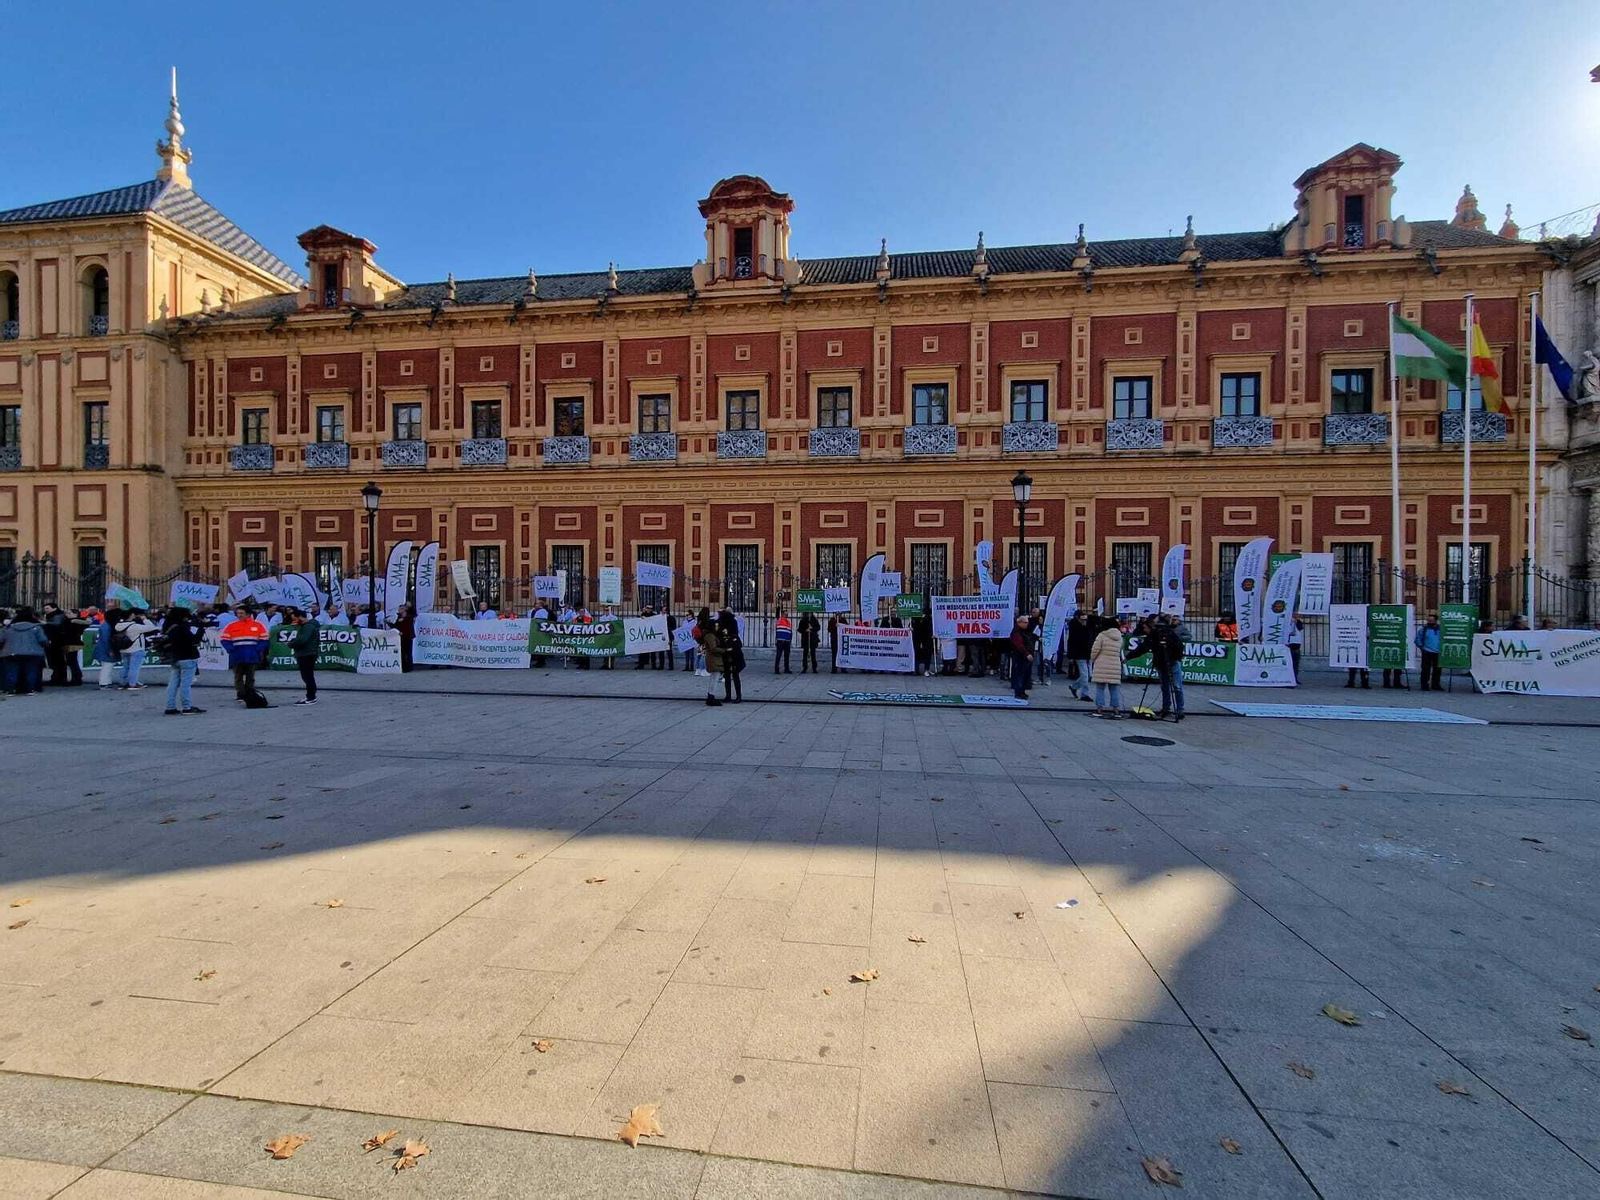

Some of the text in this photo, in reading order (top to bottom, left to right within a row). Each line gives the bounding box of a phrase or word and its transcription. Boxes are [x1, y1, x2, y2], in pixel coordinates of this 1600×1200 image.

[390, 556, 404, 588] SMA
[419, 557, 433, 588] SMA
[537, 580, 558, 591] SMA
[880, 578, 899, 588] MA
[177, 584, 208, 595] SMA
[346, 583, 361, 596] SM
[798, 593, 818, 604] SMA
[827, 594, 847, 603] SMA
[898, 599, 918, 609] SMA
[946, 610, 1001, 620] NO PODEMOS
[1241, 595, 1251, 631] SMA
[540, 622, 610, 635] SALVEMOS
[629, 625, 664, 641] SMA
[957, 621, 990, 634] MÁS
[278, 629, 357, 644] SAEMOS
[551, 635, 595, 644] nuestra
[678, 631, 692, 642] SM
[534, 645, 618, 655] ATENCIÓN PRIMARIA
[1481, 638, 1541, 658] SMA
[271, 655, 323, 665] ATENN
[423, 653, 454, 661] URGENCIAS
[1240, 646, 1284, 664] SMA
[361, 659, 400, 668] SEVILLA
[1554, 658, 1570, 667] tus
